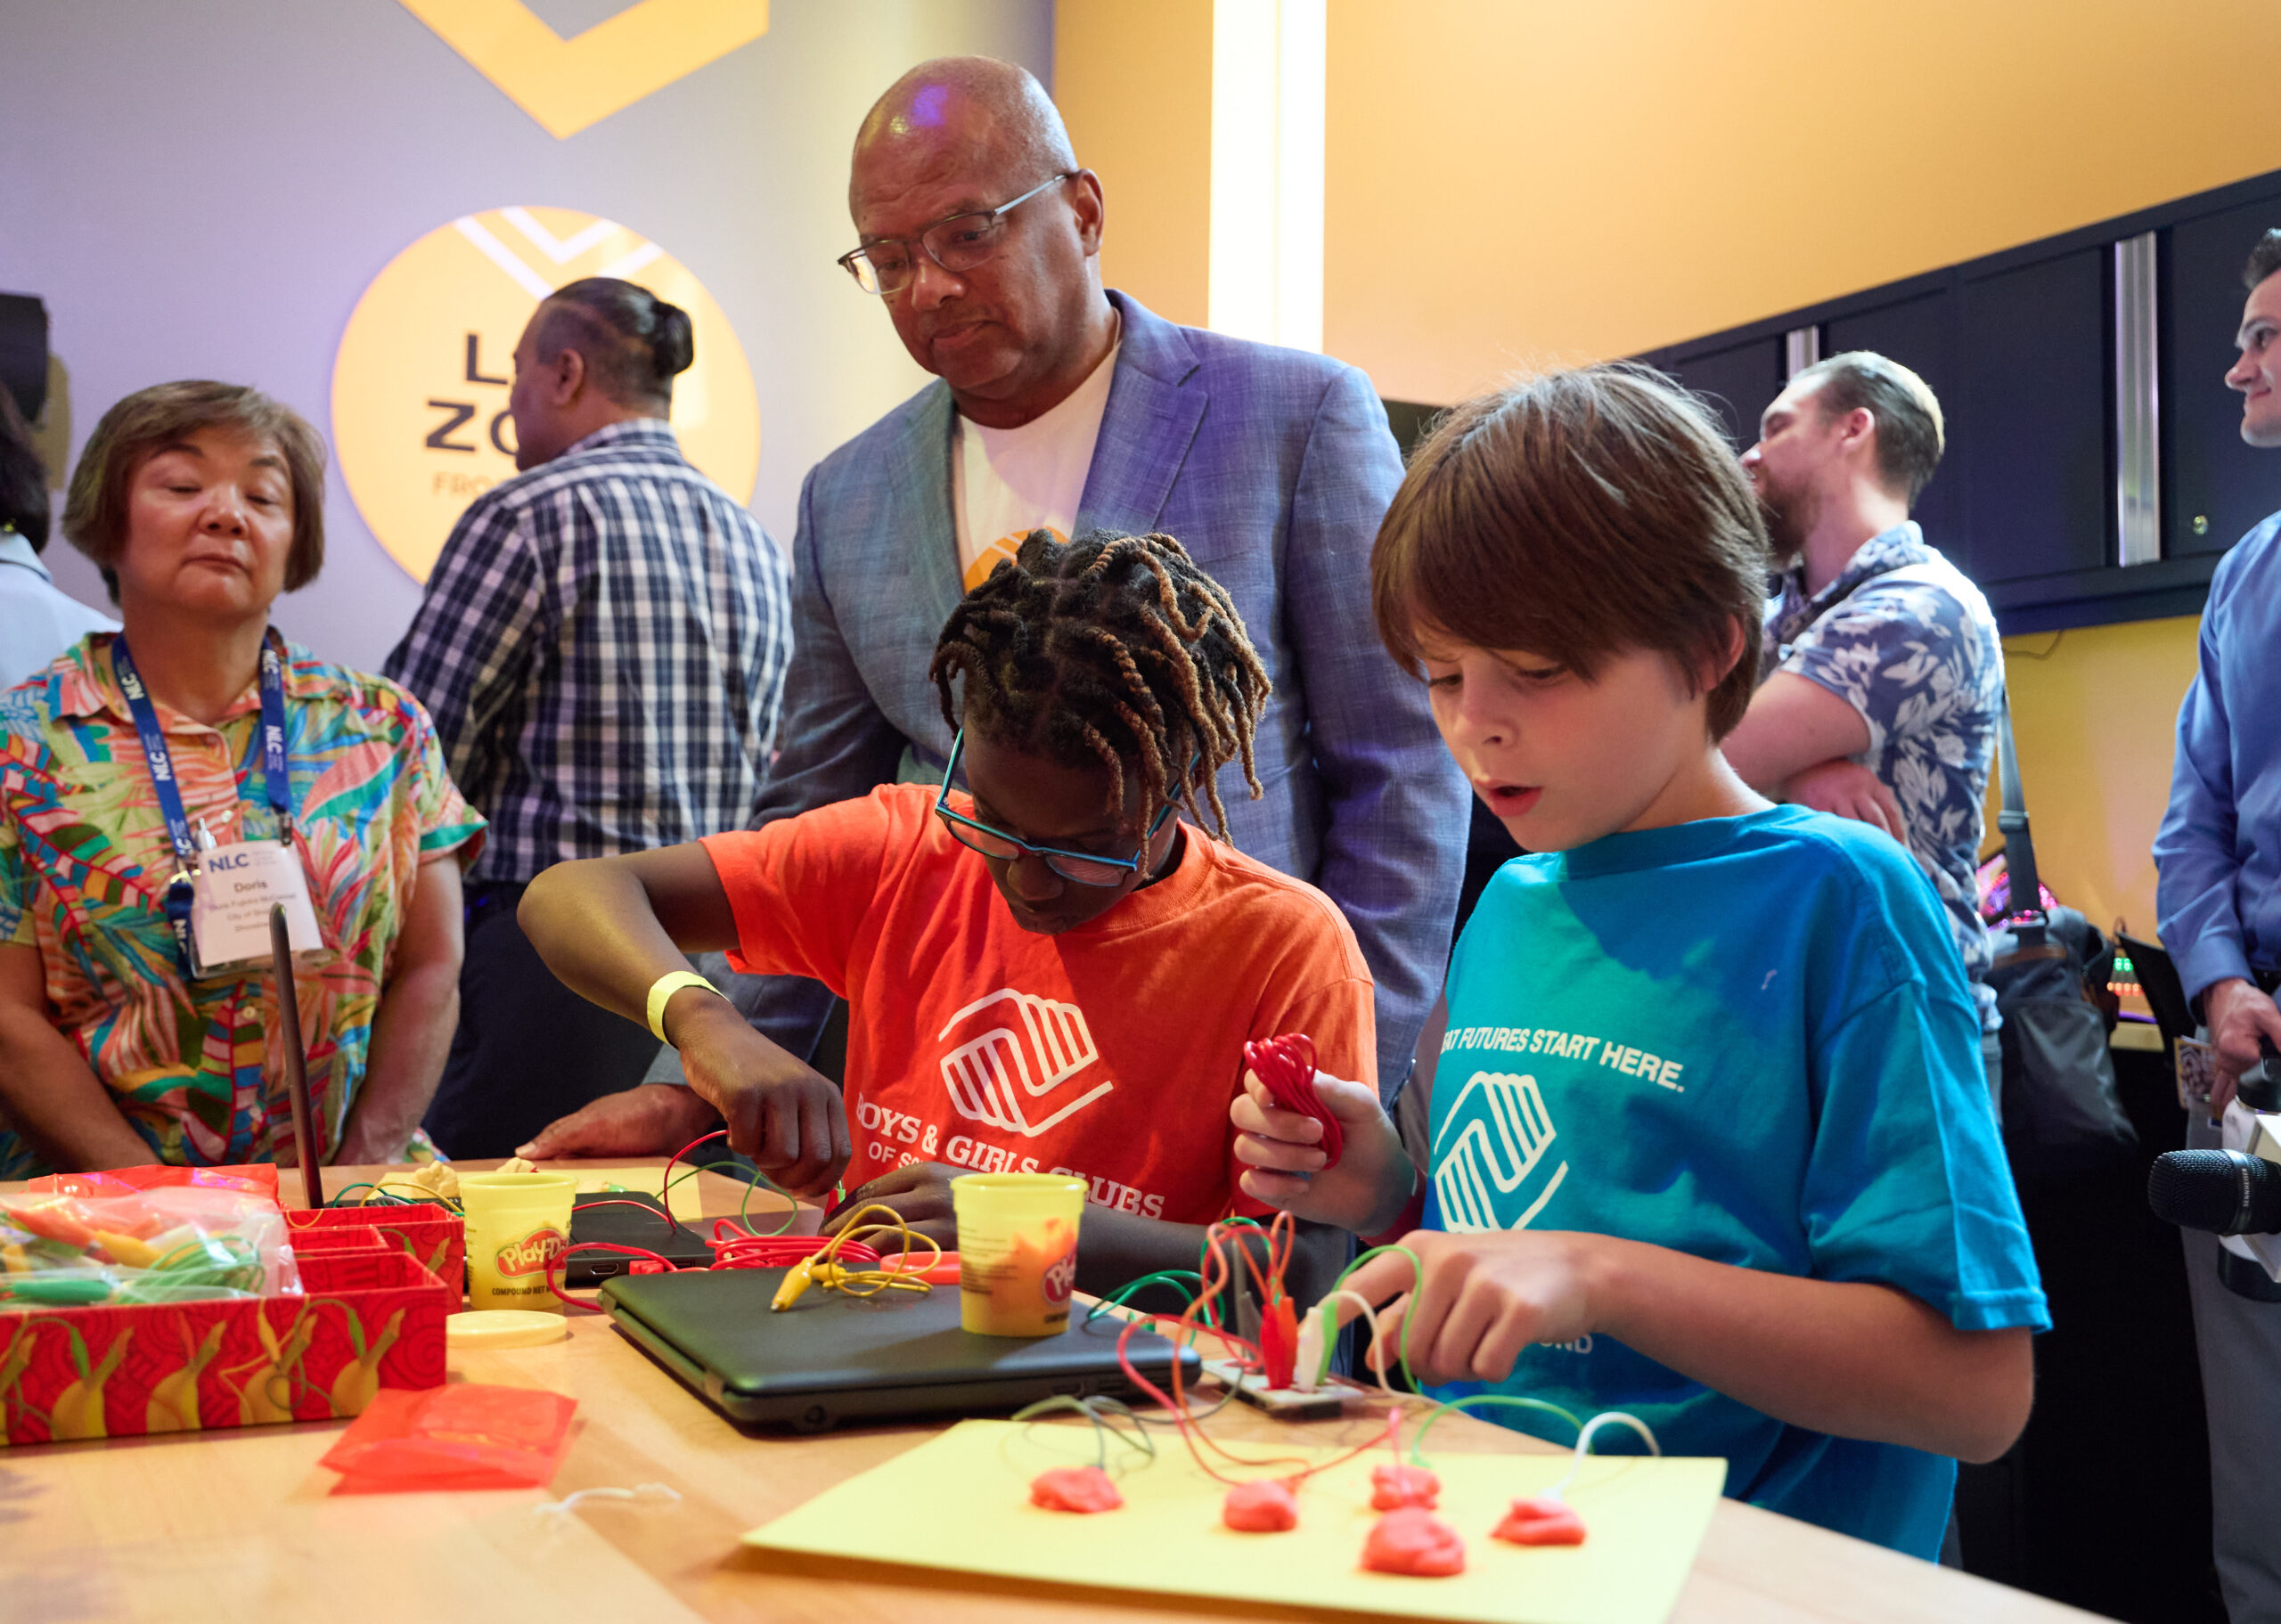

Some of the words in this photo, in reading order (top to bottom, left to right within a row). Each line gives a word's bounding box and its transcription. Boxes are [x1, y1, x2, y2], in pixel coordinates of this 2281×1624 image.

[121, 673, 144, 700] NLC
[265, 724, 283, 755] NLC
[150, 751, 172, 781] NLC
[208, 853, 249, 873] NLC
[233, 880, 268, 893] Doris
[1457, 1026, 1531, 1052] FUTURES
[1529, 1028, 1600, 1060] START
[1599, 1041, 1684, 1093] HERE.
[857, 1091, 921, 1144] BOYS
[921, 1124, 938, 1156] &
[945, 1134, 1040, 1174] GIRLS
[868, 1141, 896, 1164] OF
[492, 1286, 532, 1296] COMPOUND
[532, 1285, 545, 1295] NET
